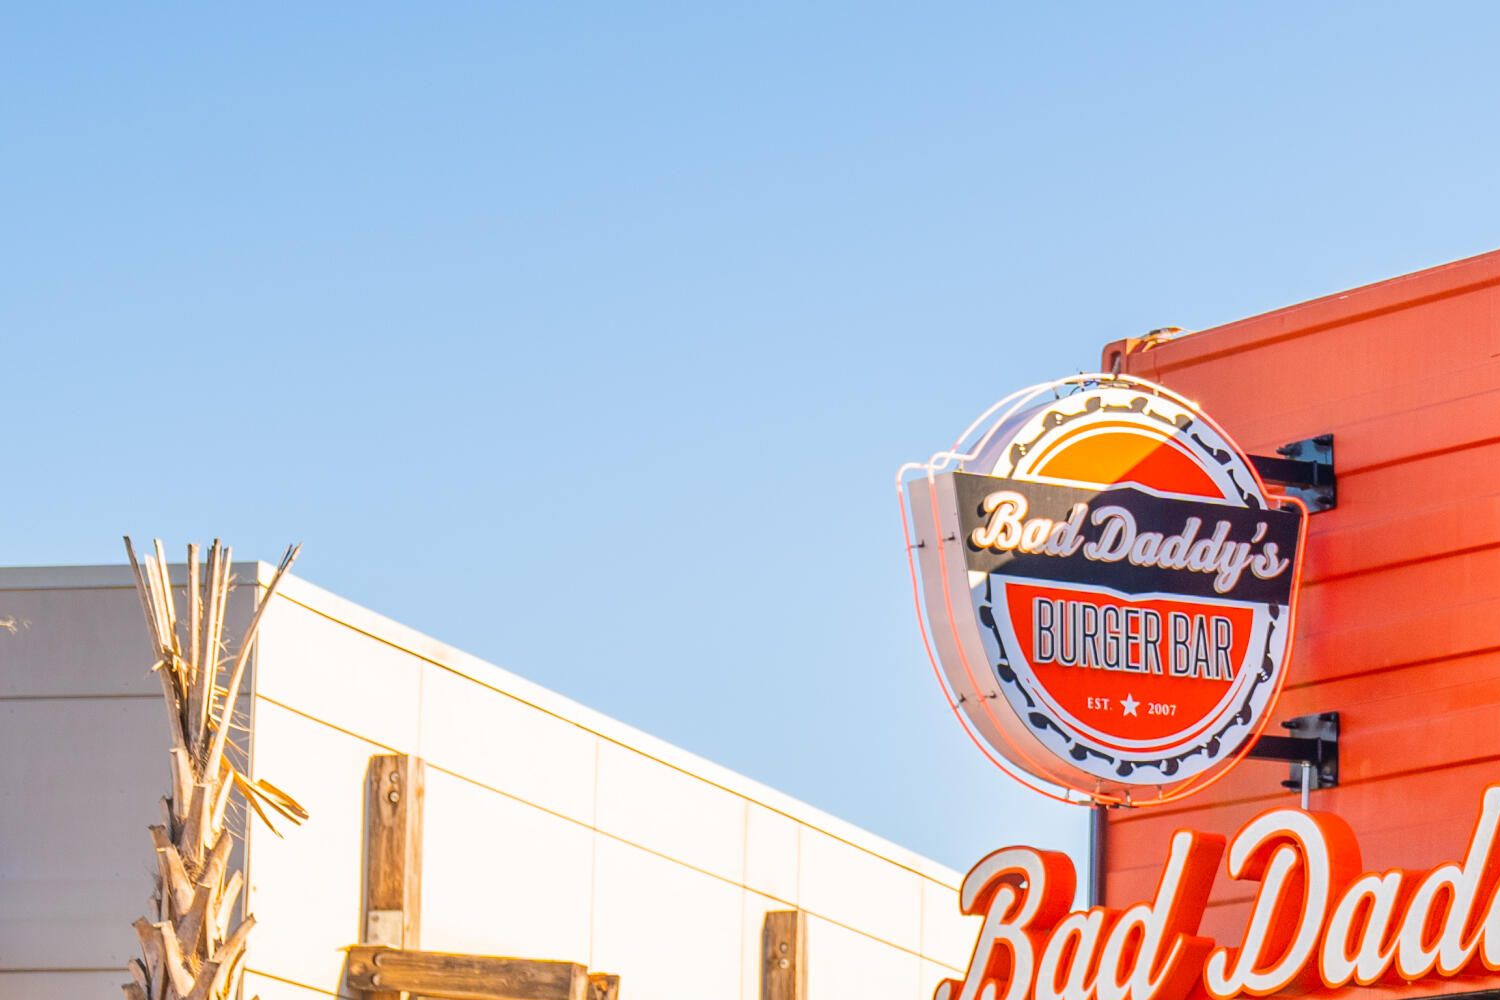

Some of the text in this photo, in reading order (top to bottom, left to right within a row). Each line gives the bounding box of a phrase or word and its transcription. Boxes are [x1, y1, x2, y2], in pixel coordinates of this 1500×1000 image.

[971, 491, 1290, 593] Bad Daddy's
[1033, 596, 1234, 682] BURGER BAR
[1087, 696, 1177, 717] EST. 2007
